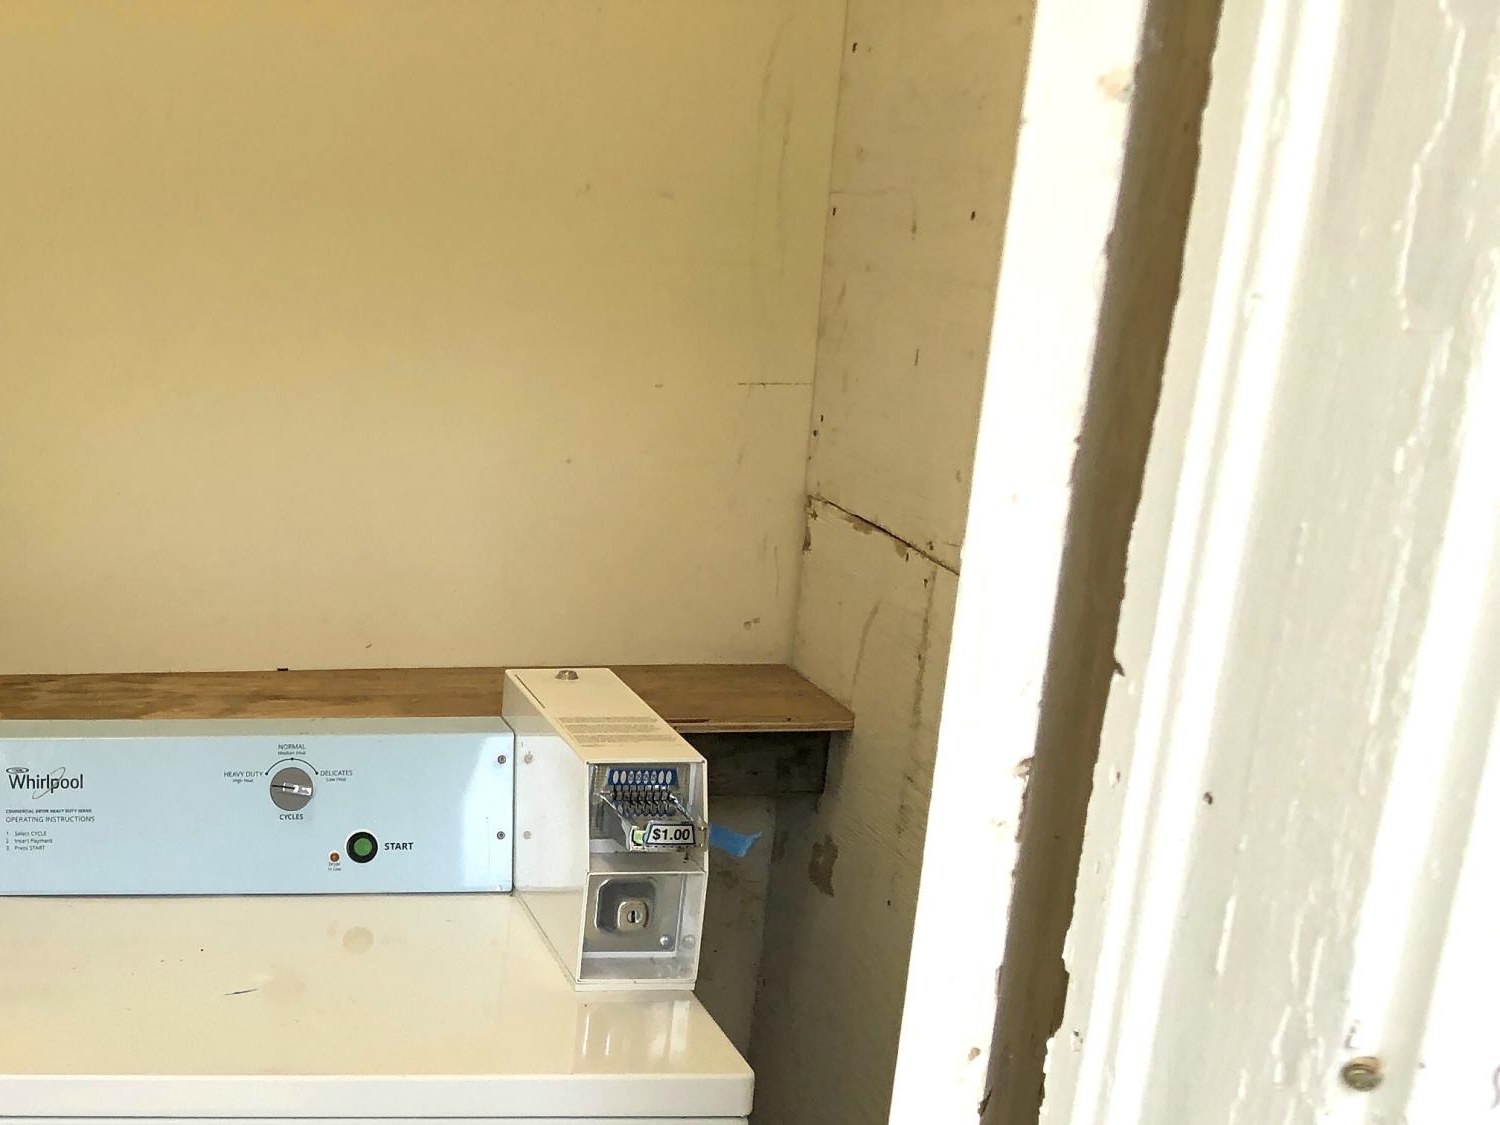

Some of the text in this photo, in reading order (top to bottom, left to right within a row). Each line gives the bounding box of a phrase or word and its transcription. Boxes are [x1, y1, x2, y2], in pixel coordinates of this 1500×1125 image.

[8, 774, 84, 794] Whirlpool
[652, 828, 691, 841] $1.00
[384, 842, 414, 850] START
